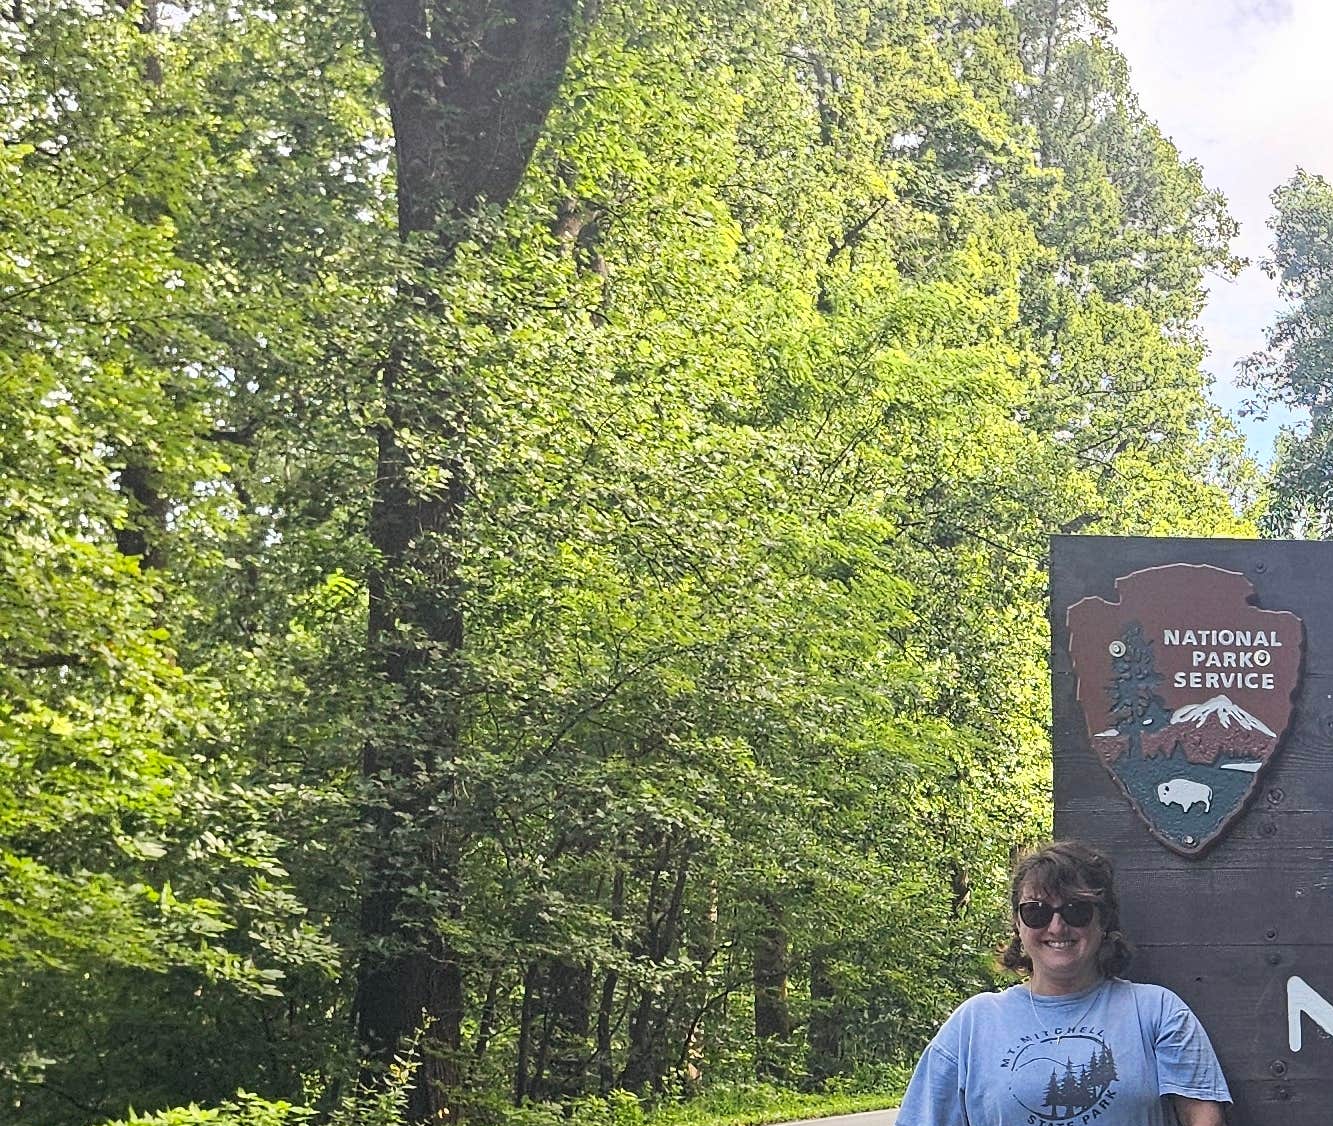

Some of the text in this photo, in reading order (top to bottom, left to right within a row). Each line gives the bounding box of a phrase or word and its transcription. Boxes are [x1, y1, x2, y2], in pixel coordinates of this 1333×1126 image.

[1163, 629, 1283, 647] NATIONAL
[1192, 650, 1255, 668] PARK
[1173, 671, 1275, 690] SERVICE
[1081, 1089, 1117, 1126] PARK
